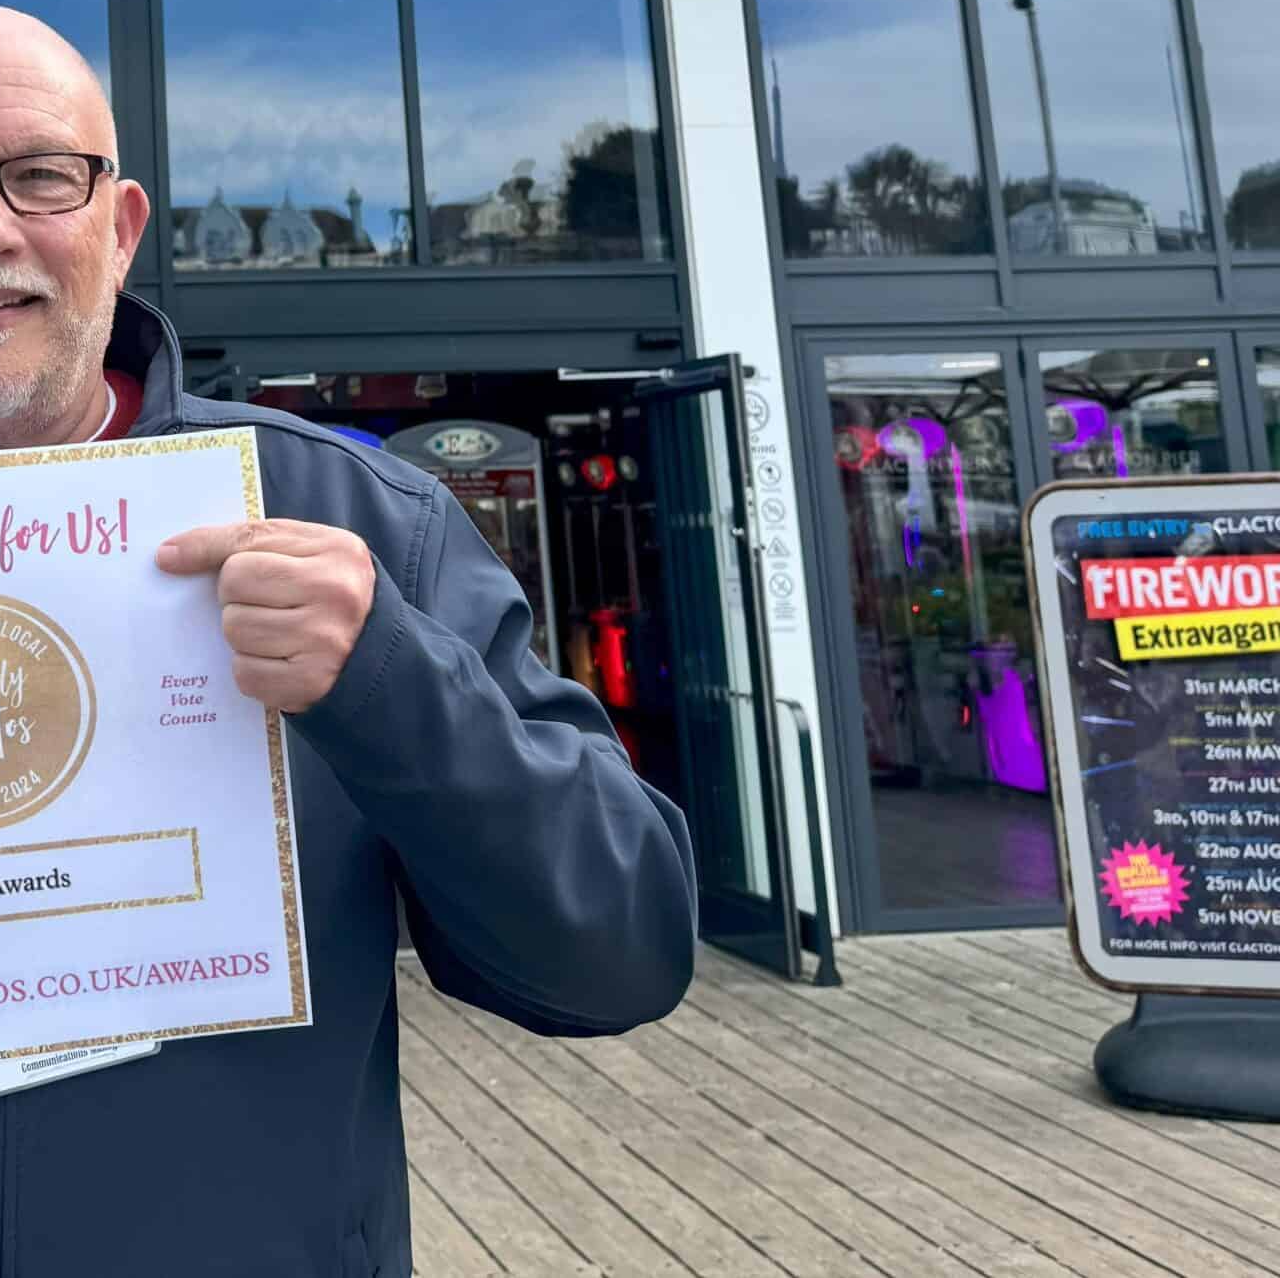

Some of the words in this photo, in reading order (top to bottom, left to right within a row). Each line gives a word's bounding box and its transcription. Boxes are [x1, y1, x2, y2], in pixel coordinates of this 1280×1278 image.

[0, 504, 60, 573] for
[67, 498, 128, 555] Us!
[161, 674, 208, 689] Every
[170, 692, 204, 706] Vote
[159, 712, 217, 726] Counts
[1236, 710, 1275, 727] MAY
[0, 769, 42, 803] 2024
[1230, 809, 1243, 826] &
[1134, 939, 1168, 950] MORE
[1170, 940, 1198, 952] INFO
[1200, 941, 1226, 952] VISIT
